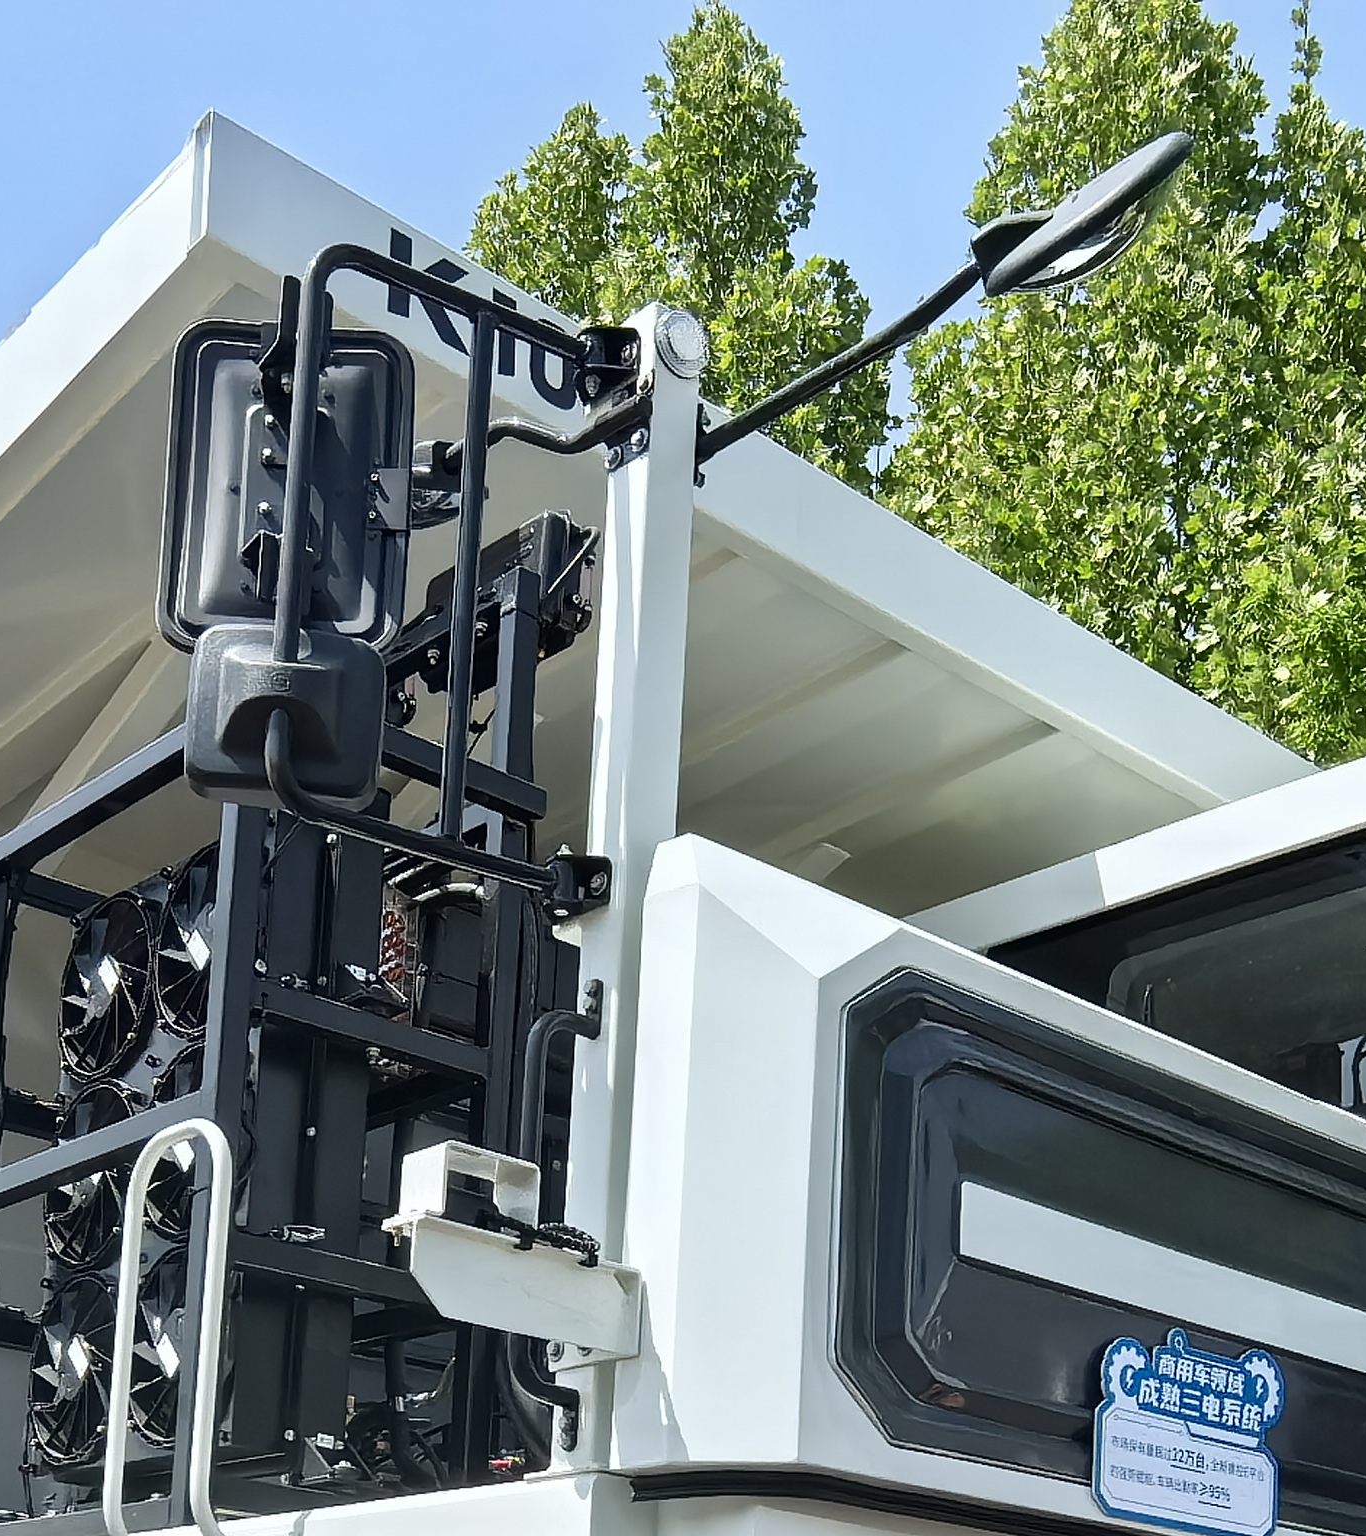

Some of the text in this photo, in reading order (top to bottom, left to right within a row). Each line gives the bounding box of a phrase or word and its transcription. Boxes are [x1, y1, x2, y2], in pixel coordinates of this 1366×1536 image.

[1156, 1354, 1246, 1398] 商用车领域
[1137, 1377, 1264, 1432] 成熟三电系统
